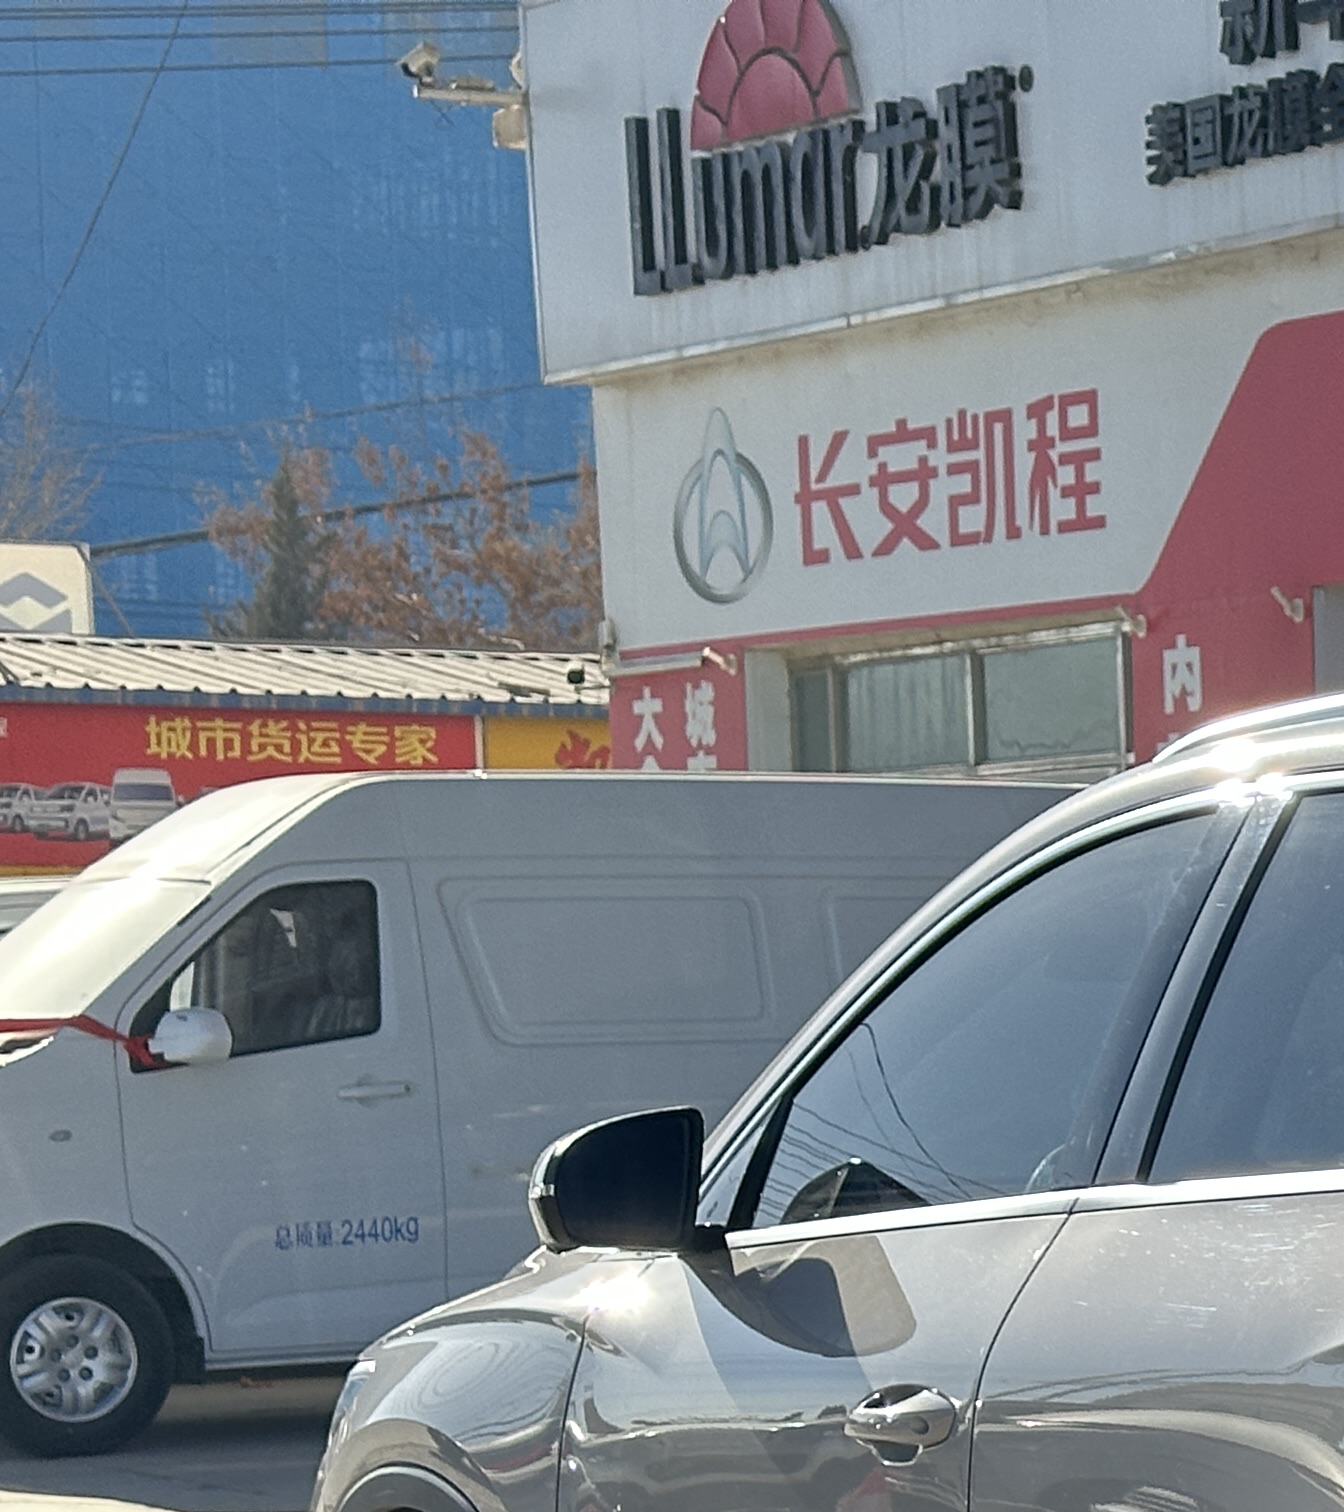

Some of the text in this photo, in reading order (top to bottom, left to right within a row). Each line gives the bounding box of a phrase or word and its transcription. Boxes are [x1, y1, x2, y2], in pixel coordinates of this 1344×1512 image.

[794, 387, 1107, 566] 长安凯程
[144, 713, 440, 766] 城市货运专家
[341, 1215, 419, 1245] 2440kg
